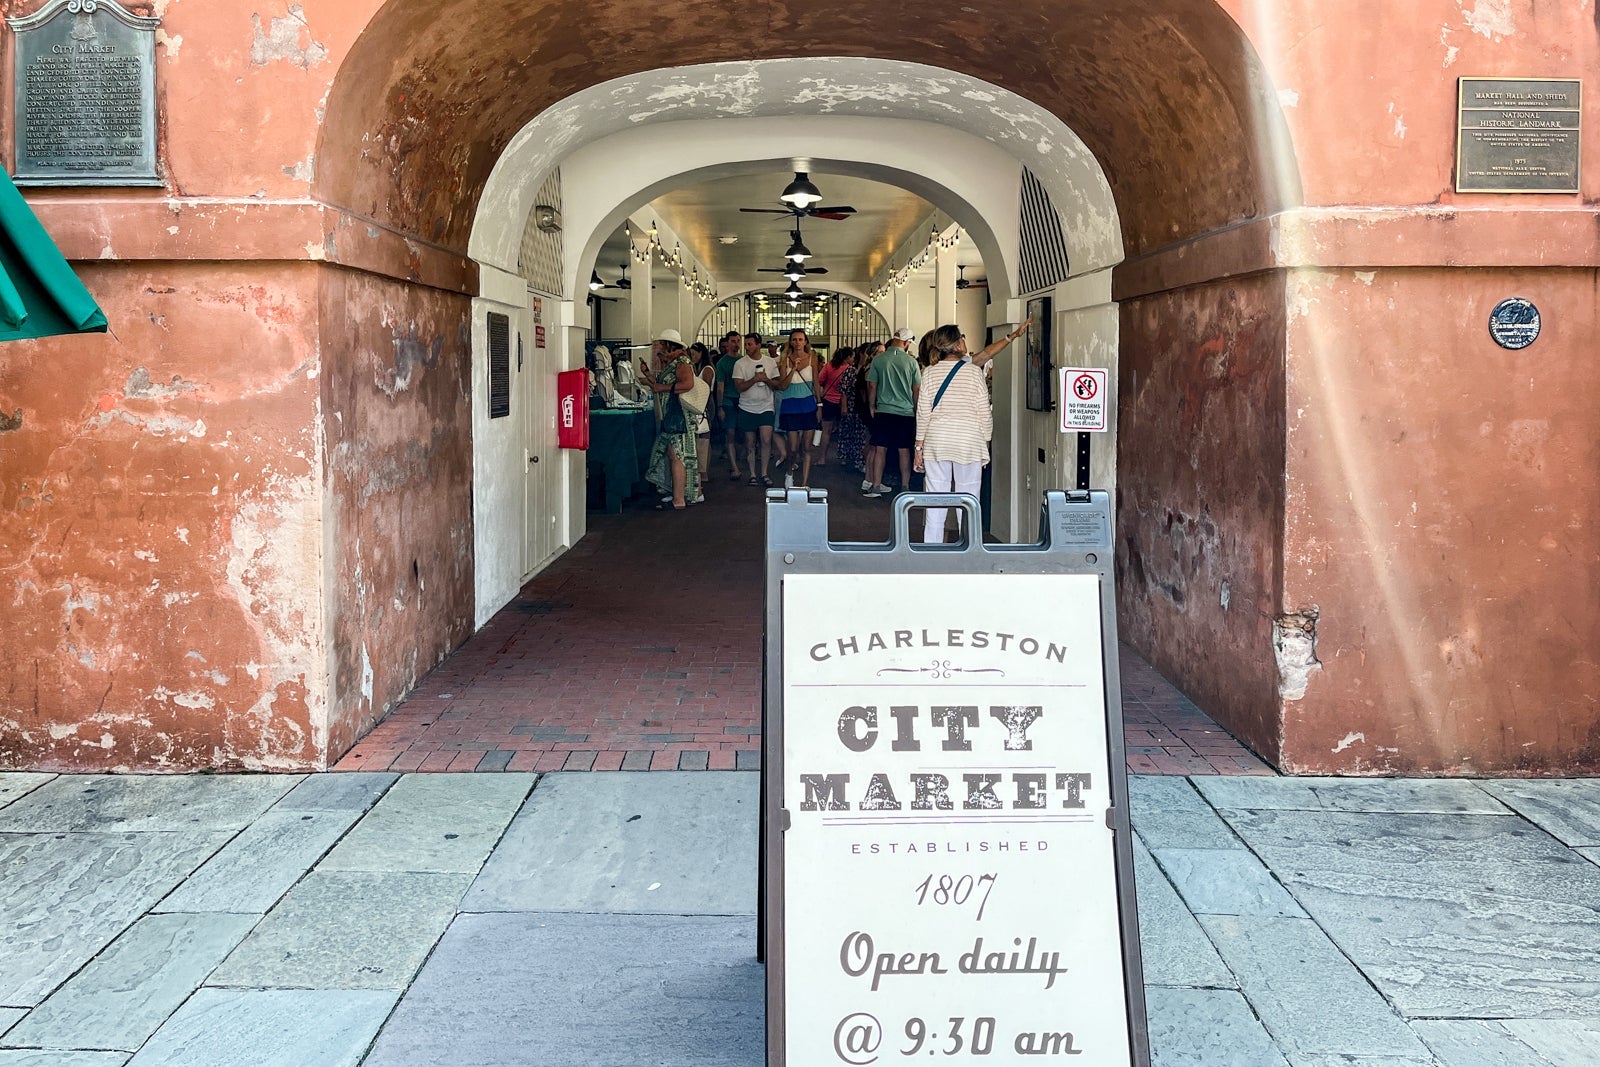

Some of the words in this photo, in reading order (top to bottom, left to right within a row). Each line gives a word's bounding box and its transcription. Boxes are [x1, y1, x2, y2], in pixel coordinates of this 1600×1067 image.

[52, 44, 74, 54] CITY
[79, 43, 115, 53] MARKET
[1520, 120, 1561, 128] LANDMARK
[809, 628, 1067, 663] CHARLESTON
[837, 705, 1043, 752] CITY
[800, 773, 1092, 811] MARKET
[851, 841, 1048, 854] ESTABLISHED
[915, 873, 998, 921] 1807
[840, 931, 948, 992] Open
[958, 937, 1068, 990] daily
[833, 1012, 882, 1065] @
[900, 1017, 996, 1056] 9:30
[1014, 1032, 1083, 1055] am
